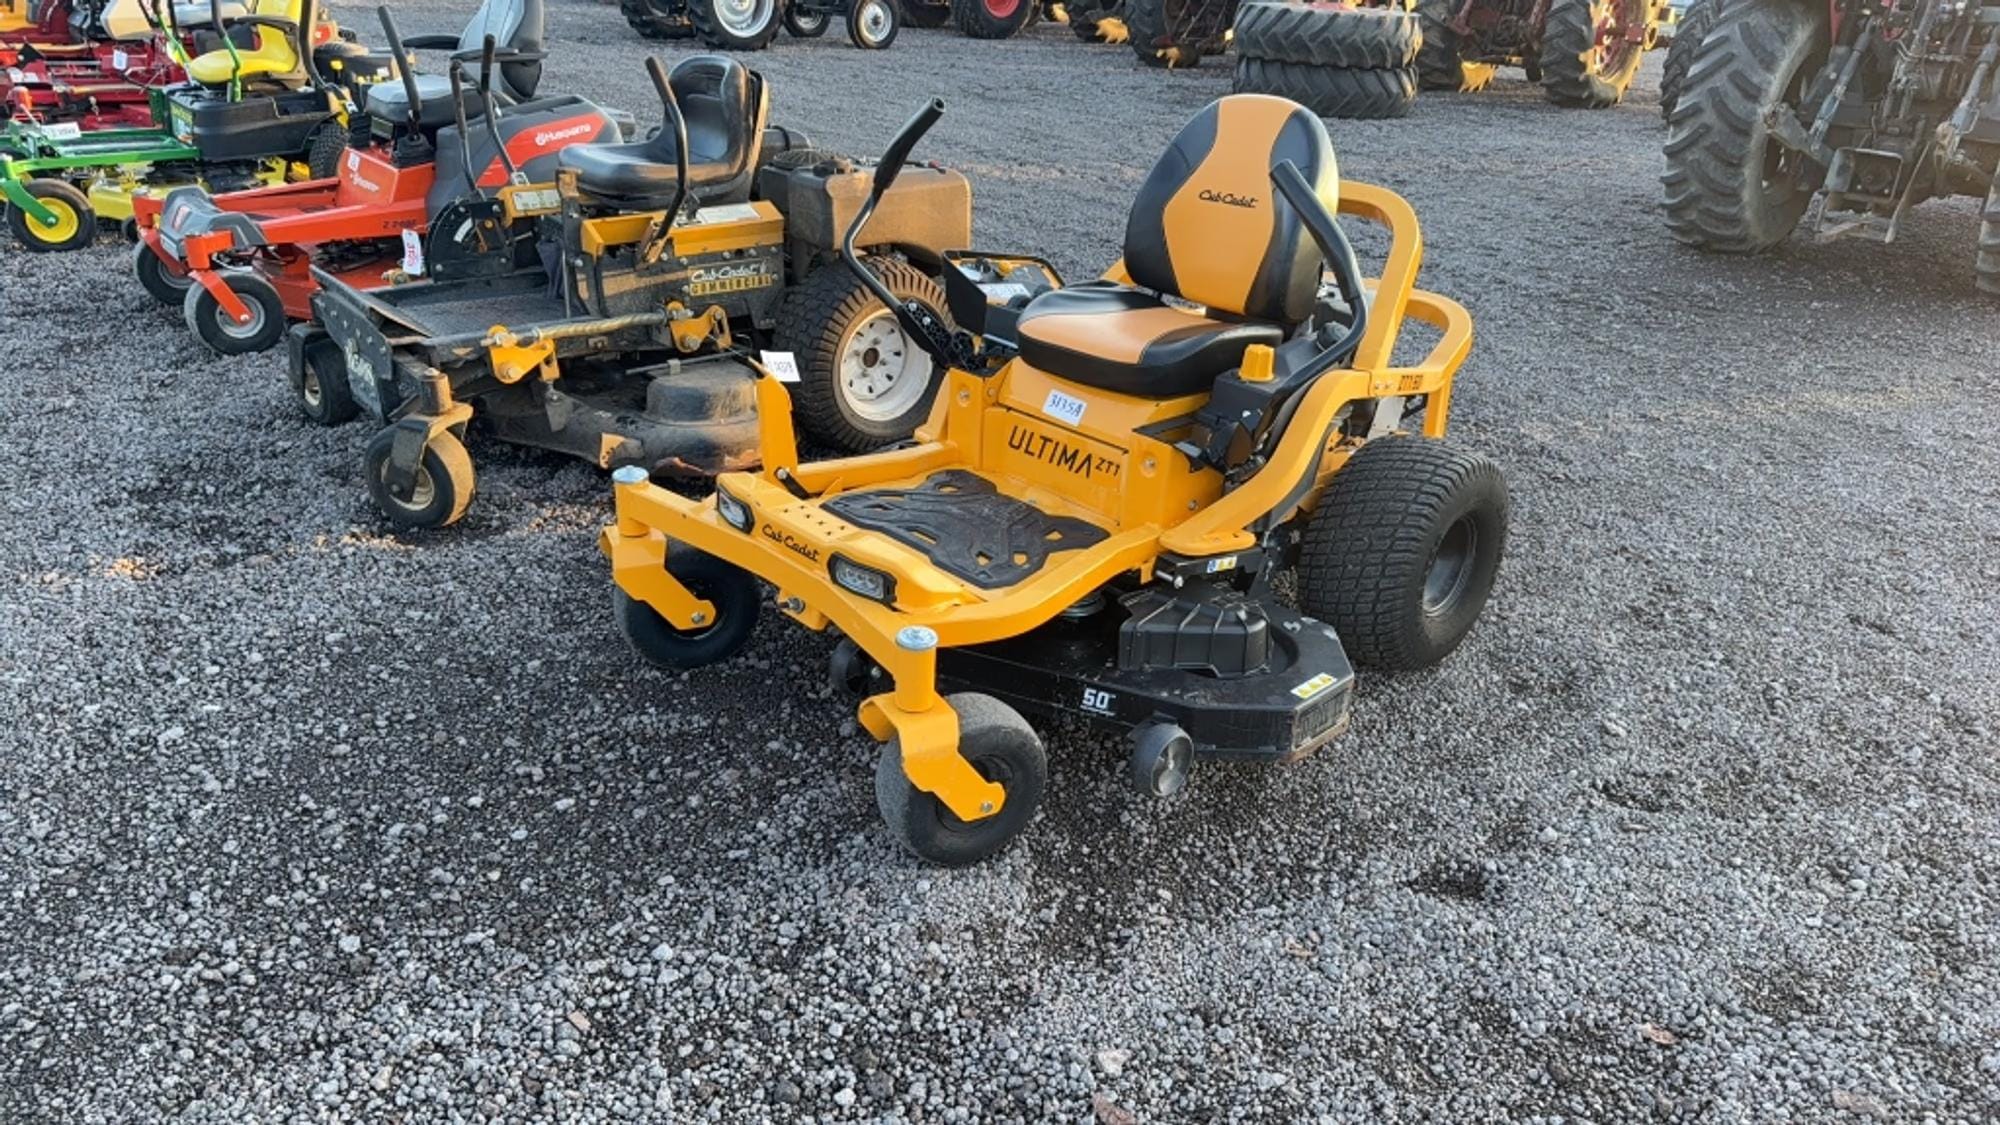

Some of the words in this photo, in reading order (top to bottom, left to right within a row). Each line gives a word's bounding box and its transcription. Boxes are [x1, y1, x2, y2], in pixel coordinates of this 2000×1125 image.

[545, 123, 592, 142] Husqvarna
[1199, 189, 1222, 202] Cub
[1222, 193, 1259, 208] Cadet
[691, 268, 717, 282] Cub
[718, 263, 760, 279] Cadet
[691, 275, 770, 295] COMMERCIAL
[1048, 393, 1084, 417] 3135A
[1008, 425, 1093, 478] ULTIMA
[1095, 457, 1121, 477] ZT1
[762, 523, 783, 544] Cub
[784, 535, 820, 563] Cadet
